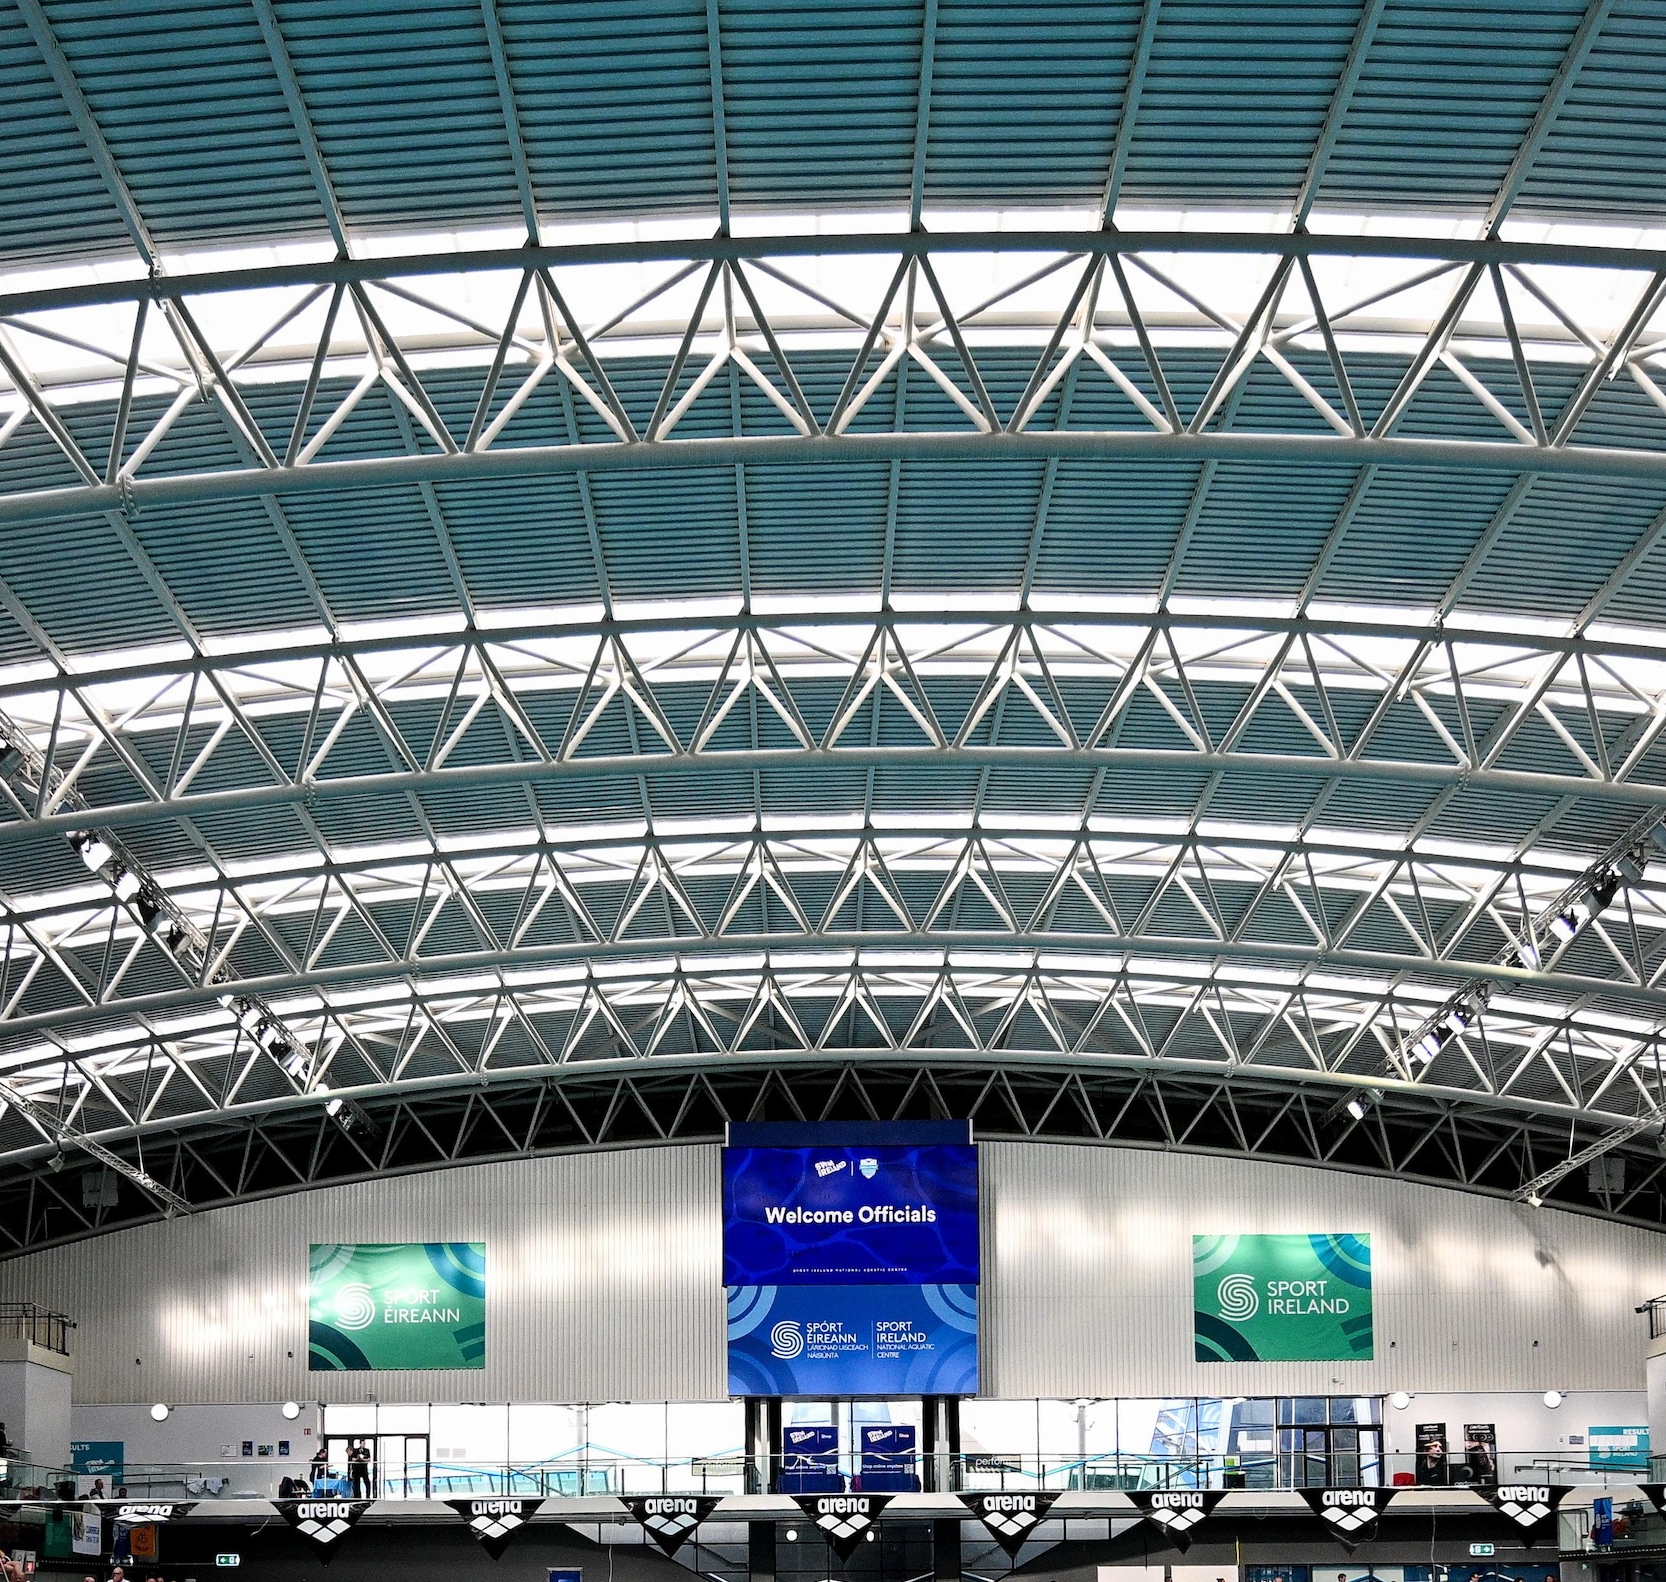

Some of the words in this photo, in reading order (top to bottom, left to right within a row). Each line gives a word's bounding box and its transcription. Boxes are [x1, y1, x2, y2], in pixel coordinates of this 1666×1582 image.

[765, 1206, 853, 1224] Welcome
[858, 1205, 937, 1224] Officials
[1267, 1280, 1328, 1297] SPORT
[384, 1305, 460, 1323] ÉIREANN
[1268, 1298, 1349, 1315] IRELAND
[806, 1320, 844, 1333] SPÓRT
[876, 1321, 913, 1332] SPORT
[806, 1331, 857, 1344] ÉIREANN
[876, 1332, 927, 1343] IRELAND
[876, 1343, 907, 1351] NATIONAL
[876, 1351, 900, 1359] CENTRE
[1151, 1492, 1204, 1508] arena
[1322, 1490, 1375, 1507] arena
[1497, 1485, 1550, 1502] arena
[119, 1504, 173, 1517] arena
[297, 1502, 350, 1519] arena
[471, 1500, 523, 1516] arena
[644, 1498, 698, 1515] arena
[817, 1497, 870, 1514] arena
[983, 1495, 1036, 1512] arena
